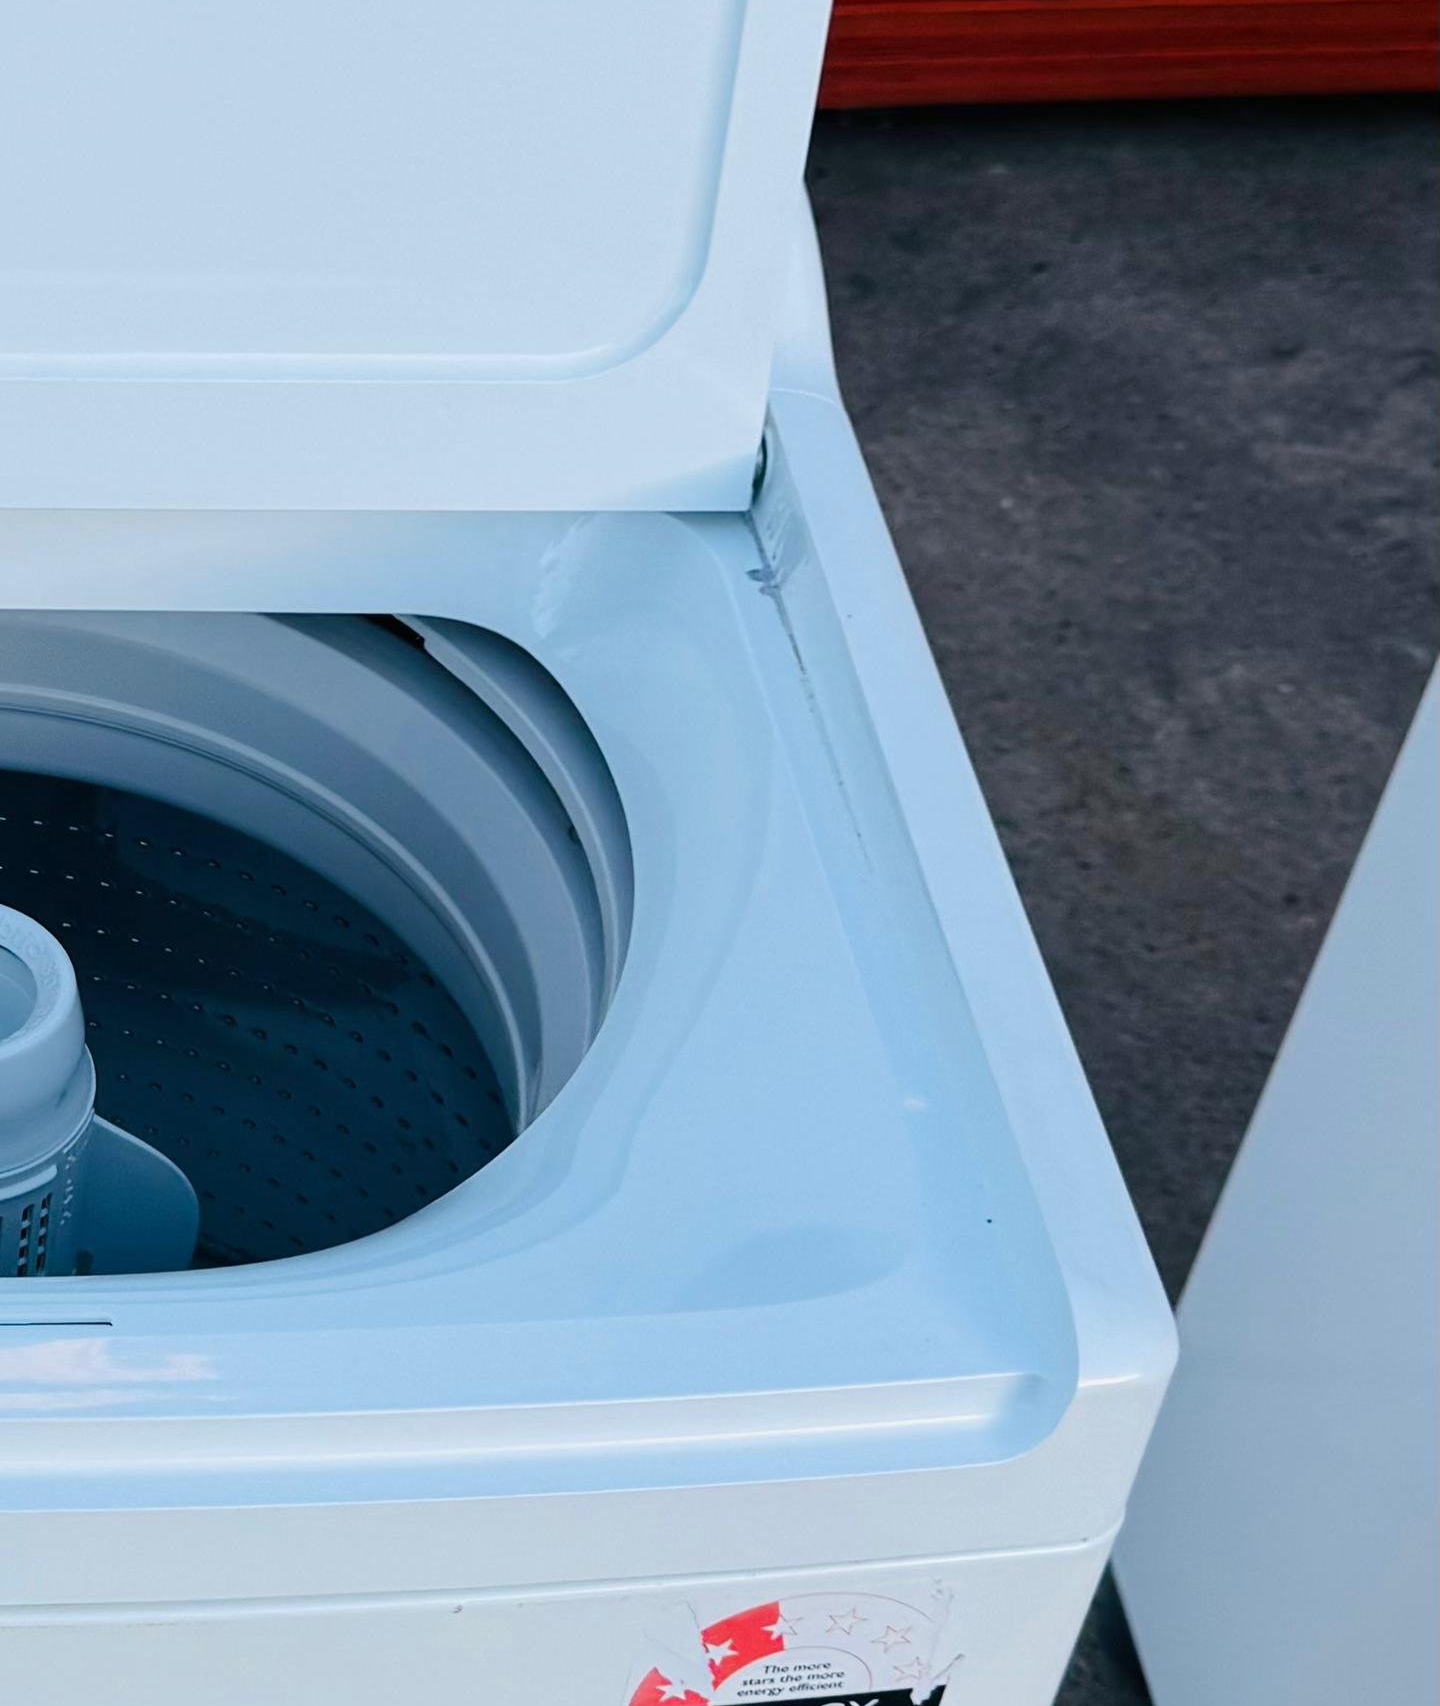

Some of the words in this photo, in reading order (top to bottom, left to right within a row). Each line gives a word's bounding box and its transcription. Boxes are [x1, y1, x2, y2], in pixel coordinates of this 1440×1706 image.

[764, 1664, 790, 1674] The
[793, 1662, 832, 1672] more
[742, 1676, 775, 1686] stars
[780, 1673, 802, 1683] the
[807, 1671, 845, 1681] more
[737, 1686, 785, 1697] energy
[789, 1680, 844, 1693] efficient
